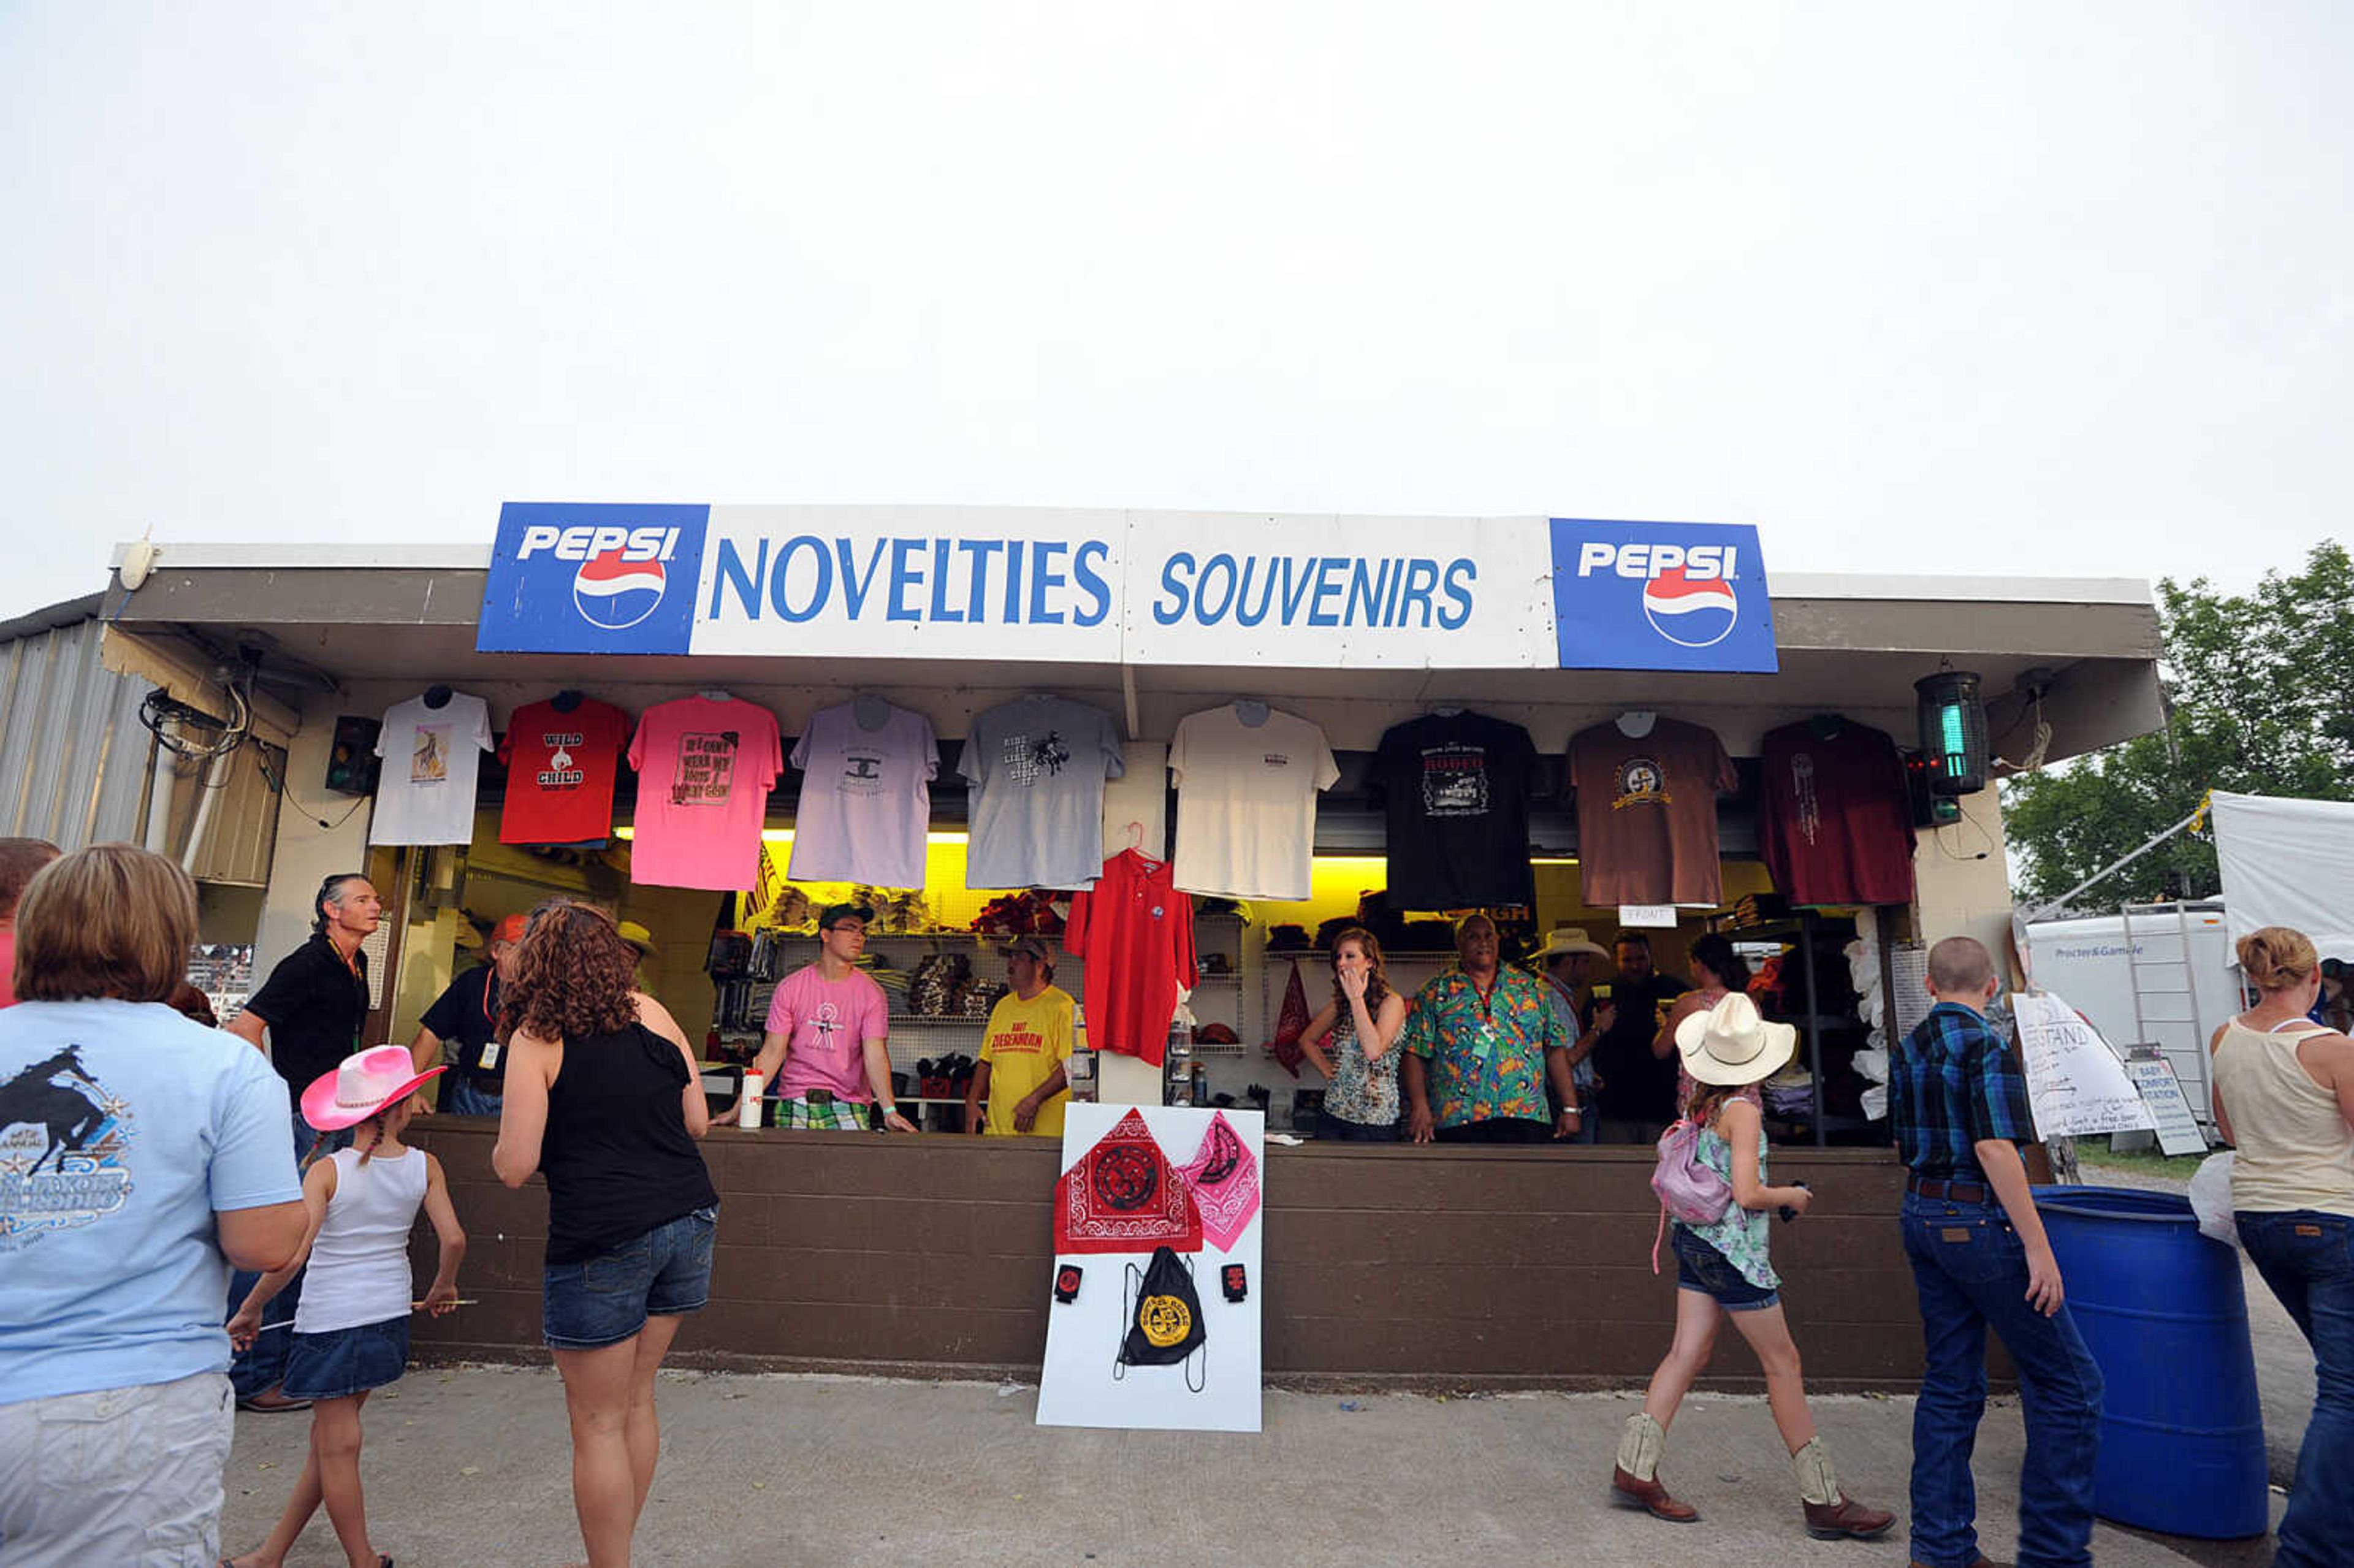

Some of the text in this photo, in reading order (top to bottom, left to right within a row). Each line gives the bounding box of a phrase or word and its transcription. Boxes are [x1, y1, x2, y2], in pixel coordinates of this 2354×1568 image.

[517, 526, 680, 561] PEPSI
[1577, 542, 1737, 579] PEPSI
[709, 535, 1478, 630] NOVELTIES SOUVENIRS
[544, 734, 583, 747] WILD
[538, 770, 583, 785] CHILD
